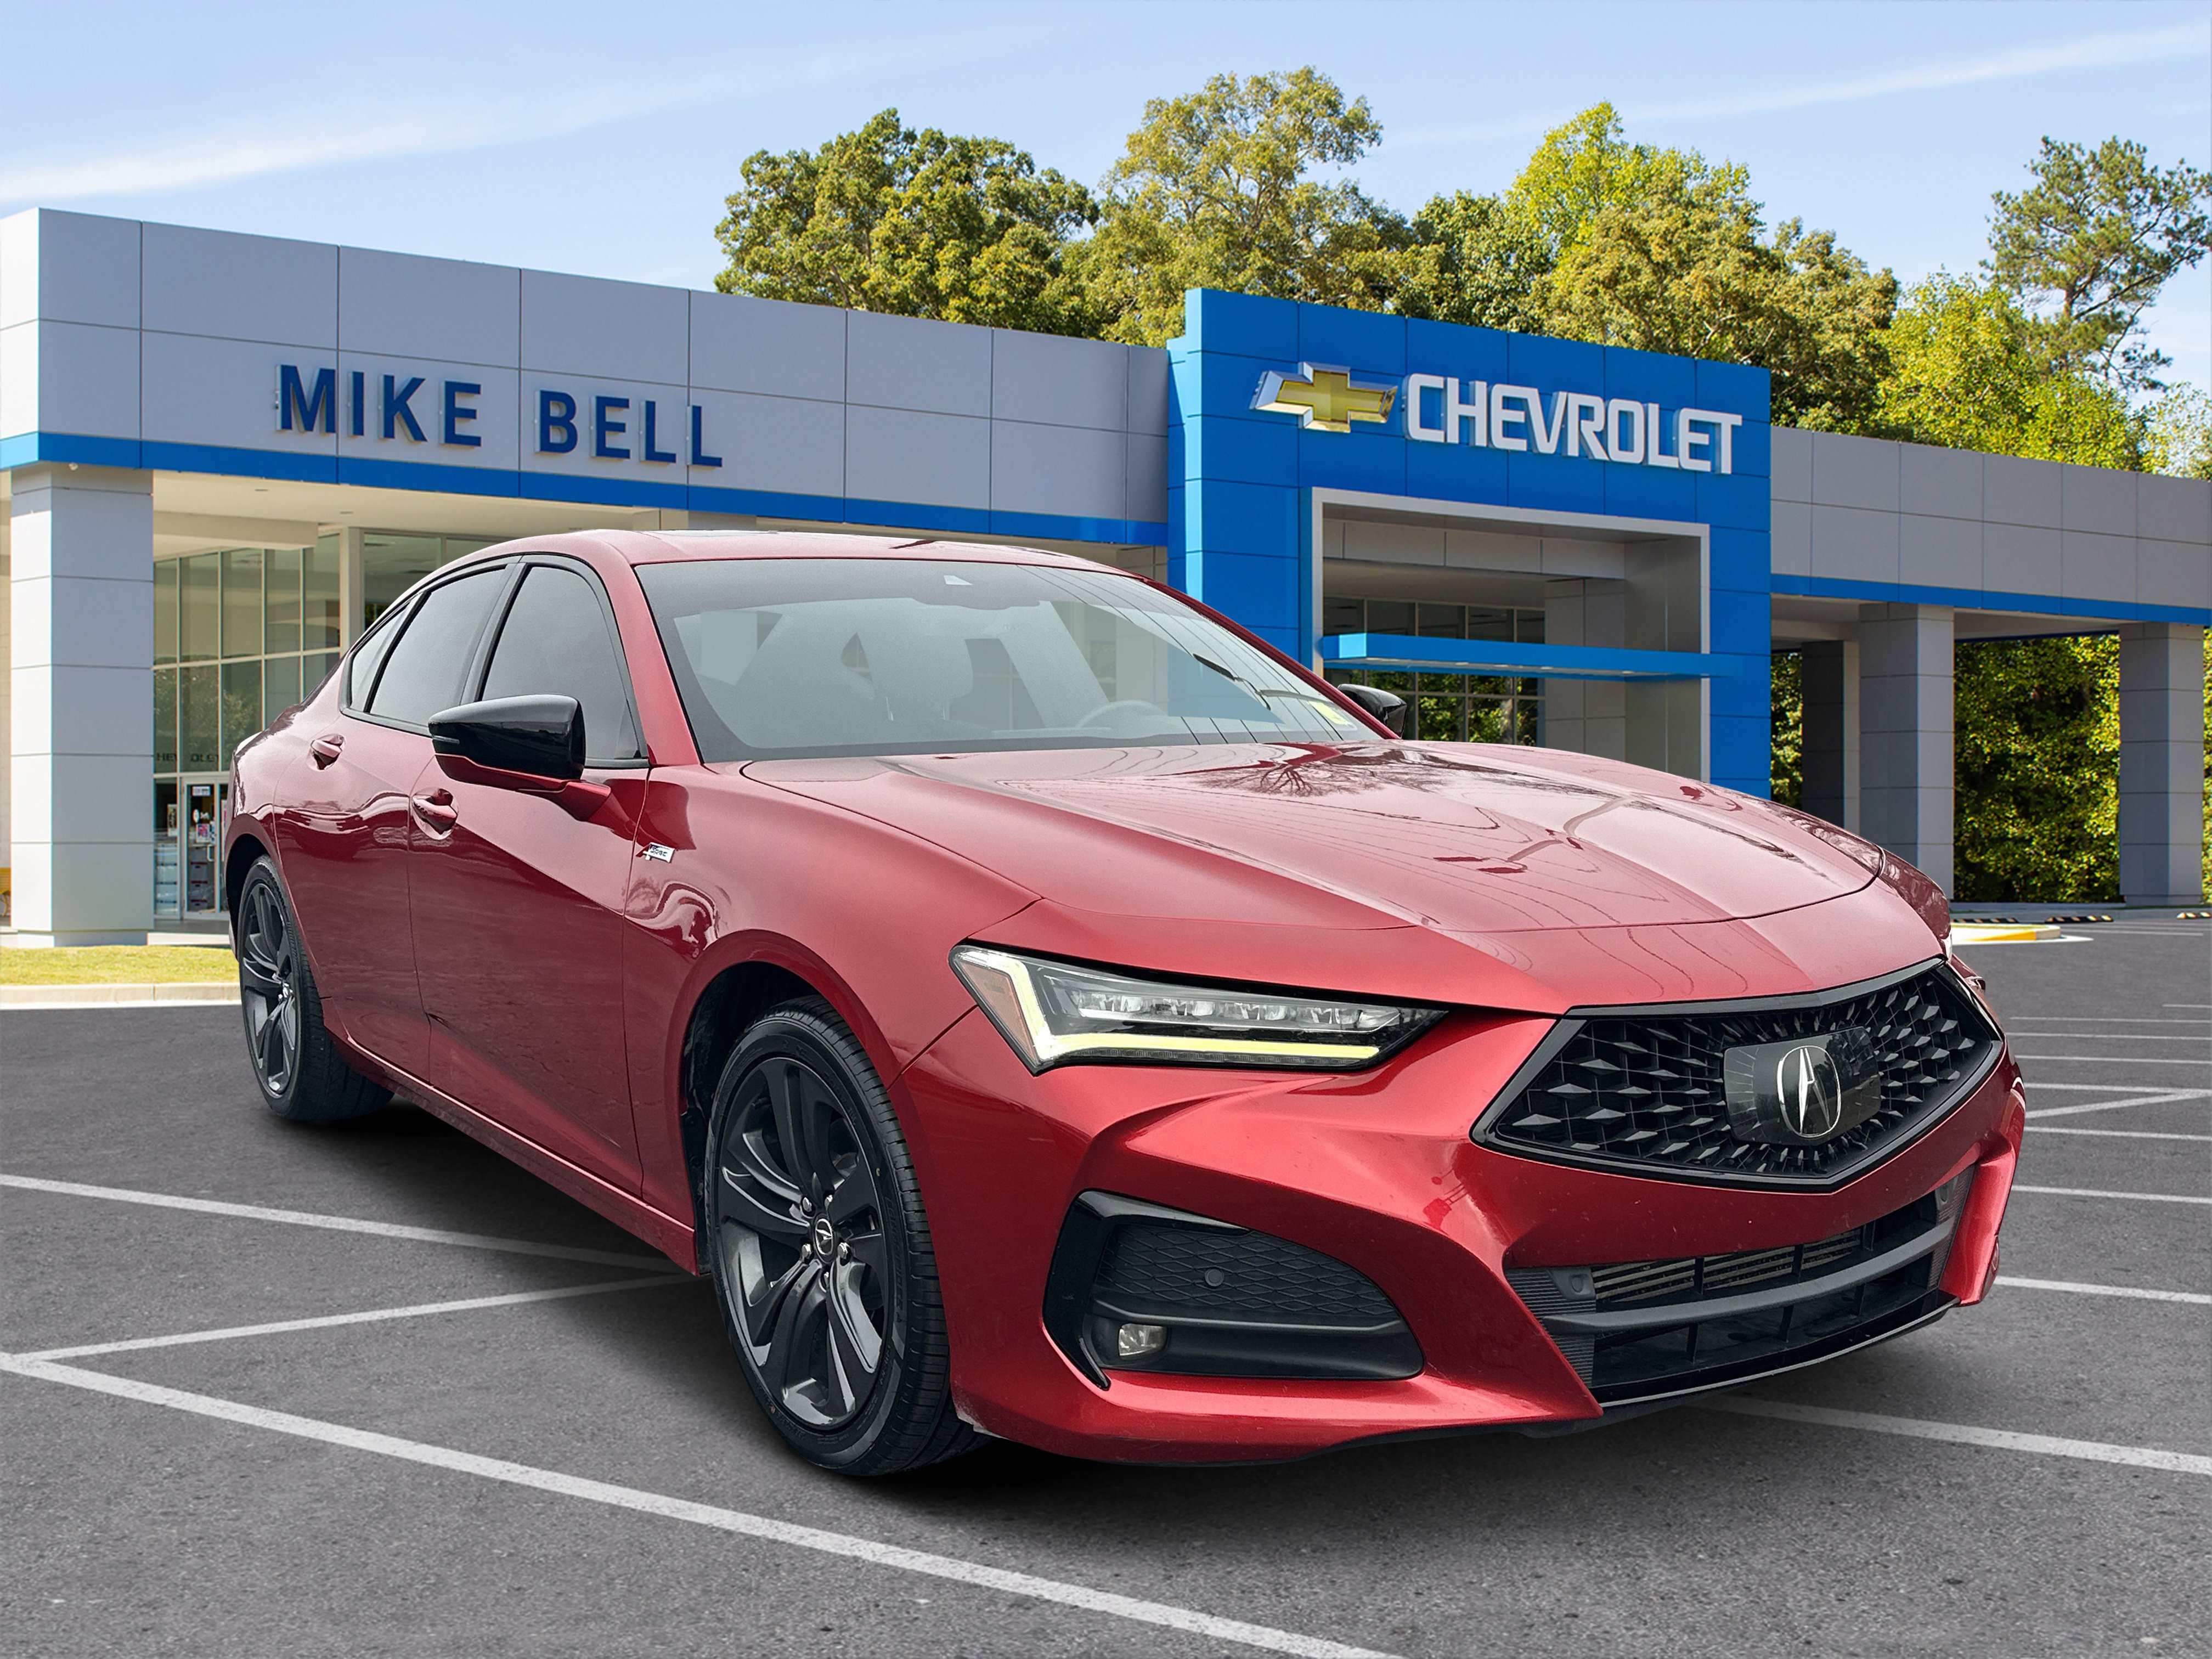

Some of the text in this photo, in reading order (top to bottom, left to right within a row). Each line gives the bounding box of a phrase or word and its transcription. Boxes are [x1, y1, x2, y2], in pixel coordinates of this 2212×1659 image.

[276, 364, 723, 467] MIKE BELL
[1402, 373, 1742, 475] CHEVROLET
